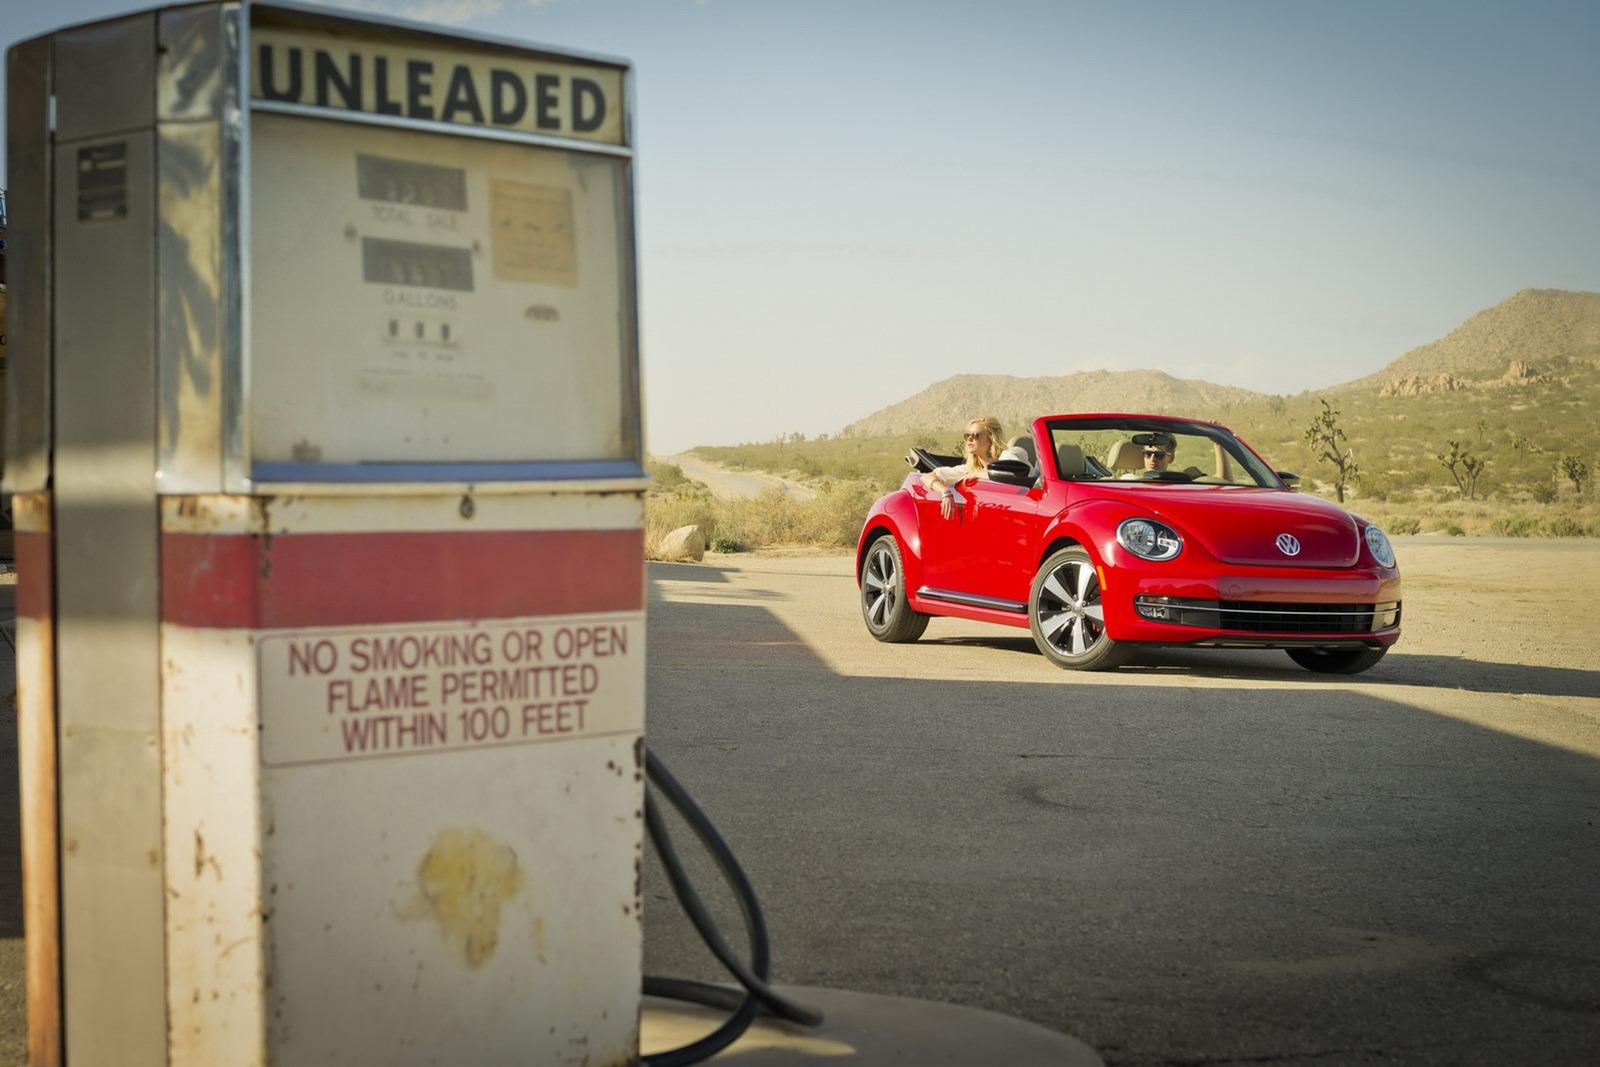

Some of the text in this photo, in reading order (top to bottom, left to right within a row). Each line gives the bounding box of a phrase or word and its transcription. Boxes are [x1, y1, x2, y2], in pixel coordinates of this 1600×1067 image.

[259, 44, 606, 132] UNLEADED
[424, 211, 459, 231] SALE
[381, 288, 458, 311] GALLONS
[288, 626, 628, 676] NO SMOKING OR OPEN
[327, 664, 599, 714] FLAME PERMITTED
[341, 700, 589, 753] WITHIN 100 FEET
